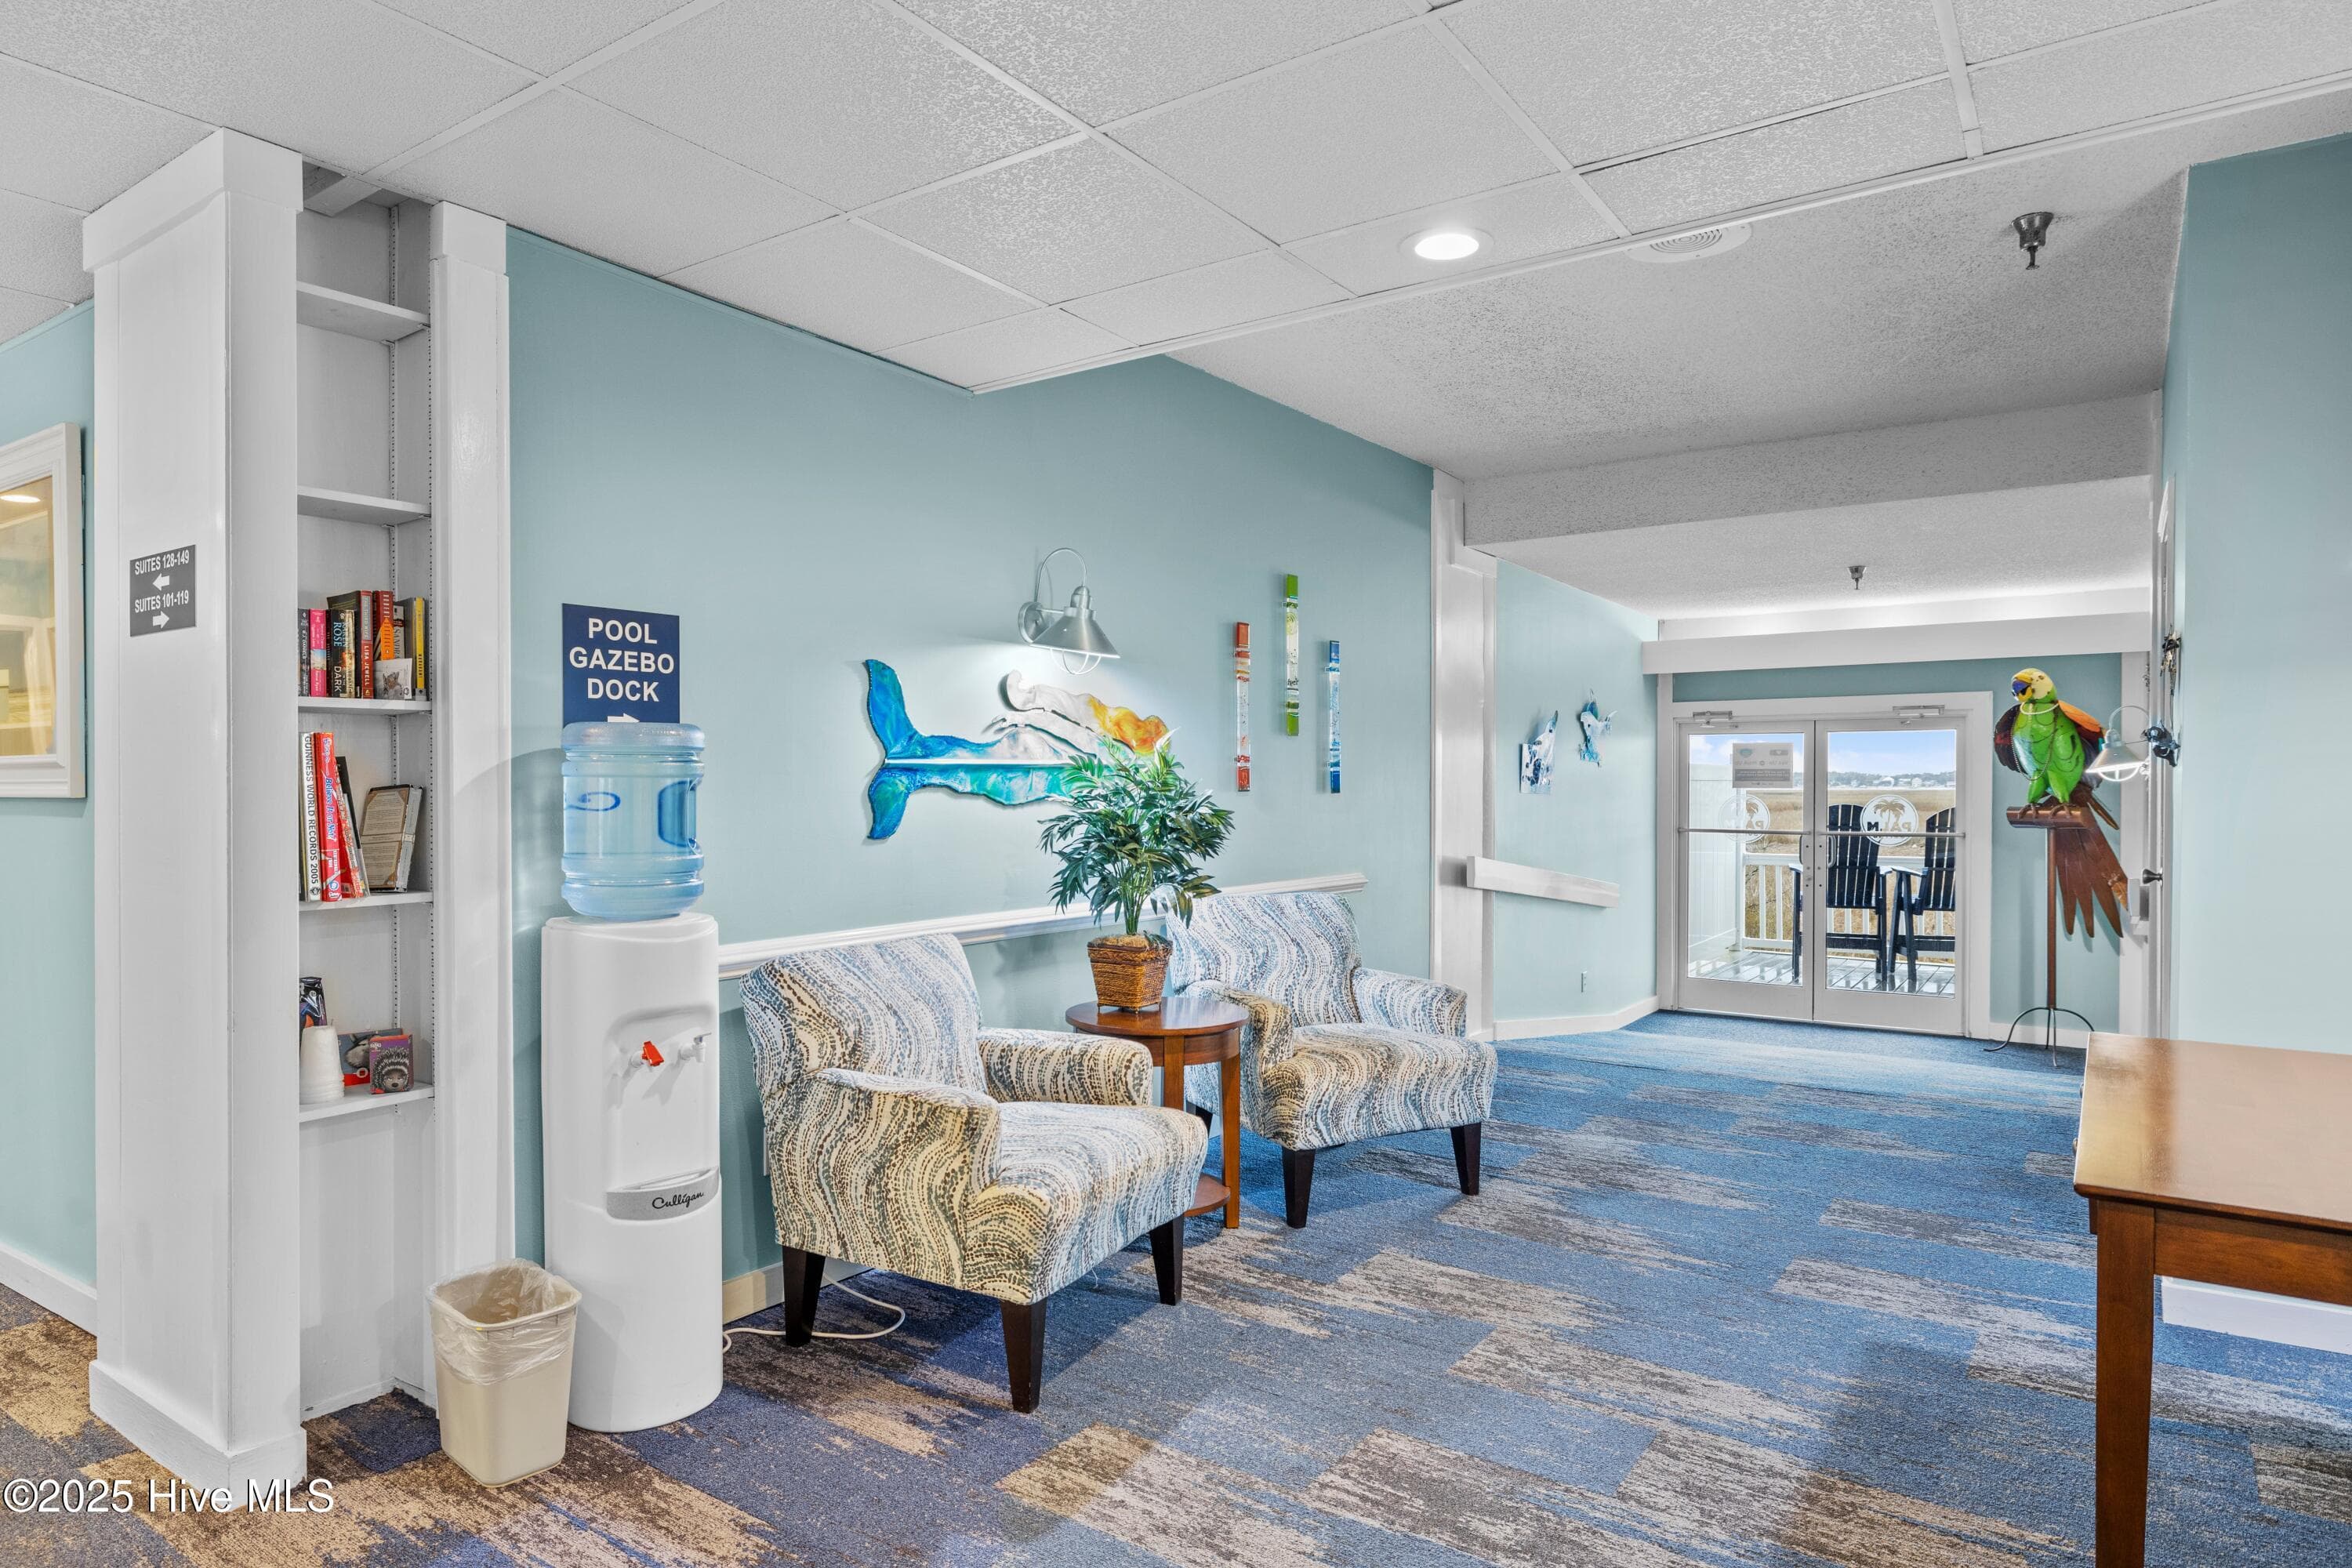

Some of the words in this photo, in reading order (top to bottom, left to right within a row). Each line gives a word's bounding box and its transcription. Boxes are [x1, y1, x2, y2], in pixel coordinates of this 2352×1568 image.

[135, 556, 161, 575] SUITES
[162, 550, 190, 569] 128-149
[135, 594, 161, 613] SUITES
[162, 590, 189, 608] 101-119
[333, 622, 342, 647] ROSE
[588, 618, 658, 644] POOL
[569, 646, 674, 674] GAZEBO
[587, 677, 659, 702] DOCK
[304, 735, 314, 782] GUINNESS
[307, 783, 315, 816] WORLD
[325, 778, 335, 804] Believe
[308, 819, 318, 861] RECORDS
[310, 863, 319, 884] 2005
[652, 1192, 704, 1210] Culligan
